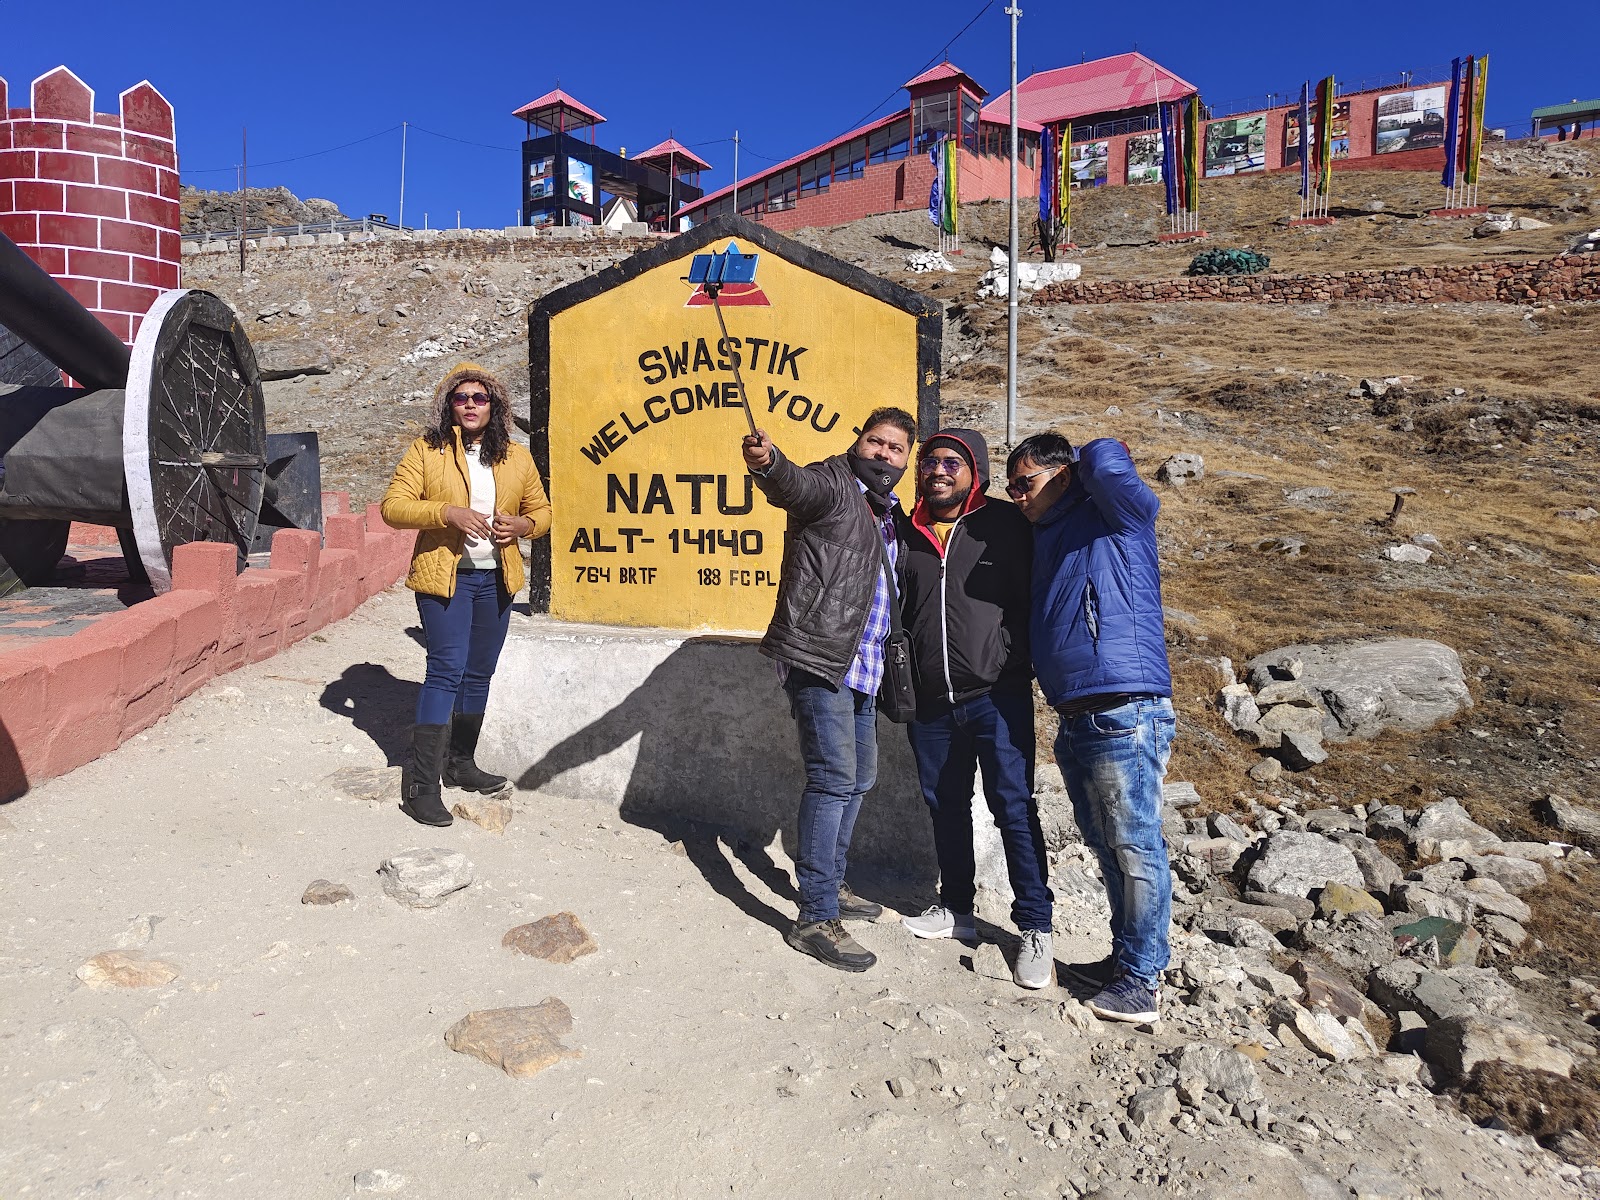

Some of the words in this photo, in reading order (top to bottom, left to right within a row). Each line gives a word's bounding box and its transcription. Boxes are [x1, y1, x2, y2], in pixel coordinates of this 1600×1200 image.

[638, 337, 808, 384] SWASTIK
[580, 382, 745, 465] WELCOME
[767, 386, 840, 432] YOU
[606, 473, 754, 515] NATU
[569, 528, 655, 553] ALT-
[668, 528, 763, 556] 14140
[574, 566, 611, 583] 764
[619, 567, 657, 584] BRTF
[697, 568, 721, 585] 188
